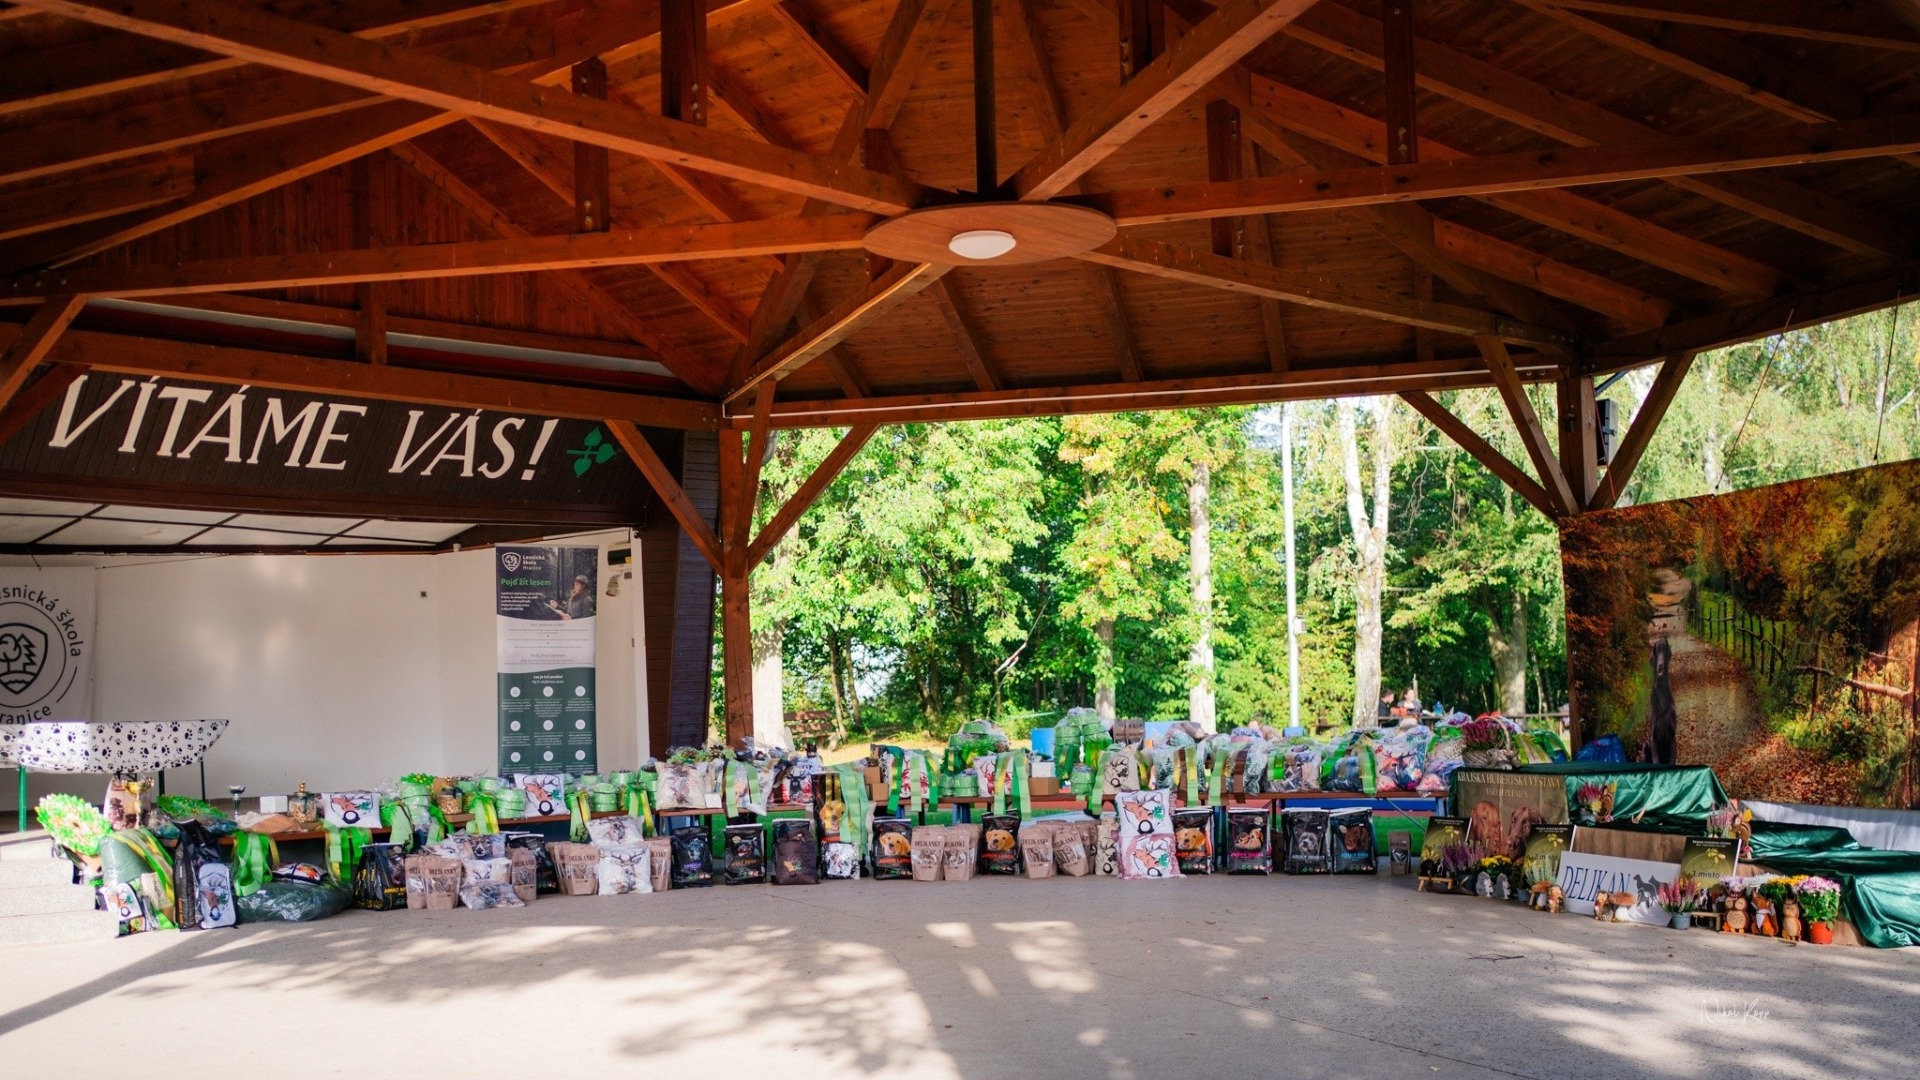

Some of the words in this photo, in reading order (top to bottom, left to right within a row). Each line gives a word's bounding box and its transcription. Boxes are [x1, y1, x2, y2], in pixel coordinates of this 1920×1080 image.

[48, 374, 368, 470] VÍTÁME
[388, 408, 560, 481] VÁS!
[501, 577, 518, 587] Pojď
[519, 577, 529, 586] žít
[530, 578, 552, 586] lesem
[0, 584, 59, 612] snická
[56, 609, 84, 657] škola
[1562, 865, 1631, 902] DELIKAN
